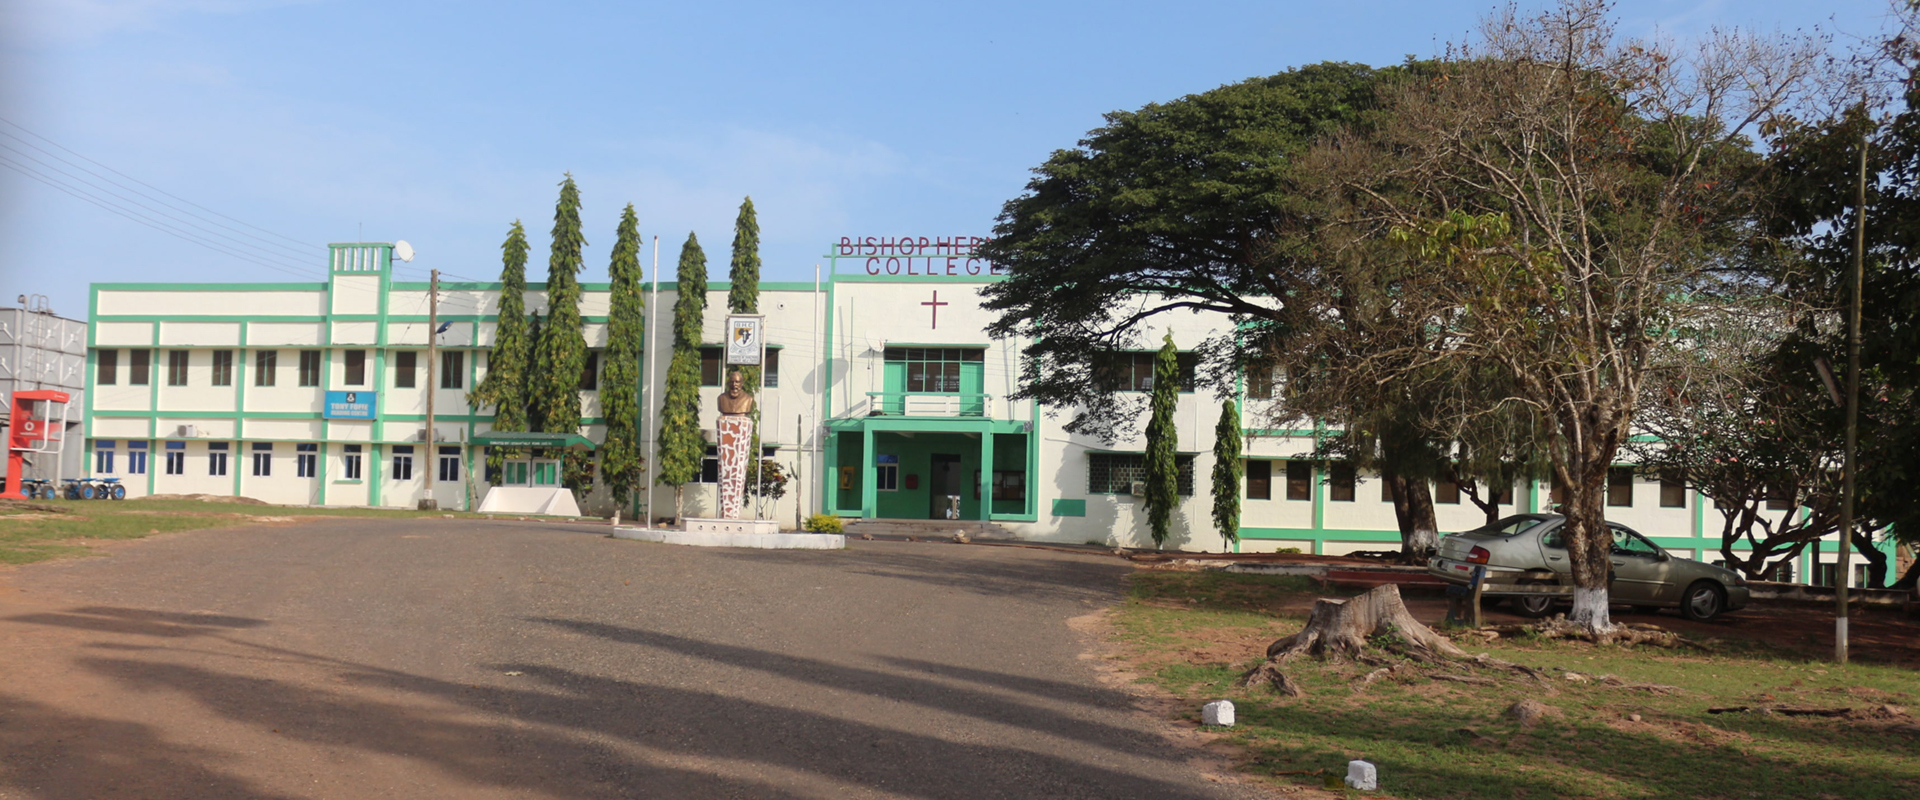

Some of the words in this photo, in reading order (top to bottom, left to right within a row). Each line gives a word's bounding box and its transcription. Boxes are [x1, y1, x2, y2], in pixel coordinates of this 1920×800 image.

[840, 236, 930, 256] BISHOP
[936, 236, 994, 256] HER
[865, 256, 1003, 276] COLLEGE
